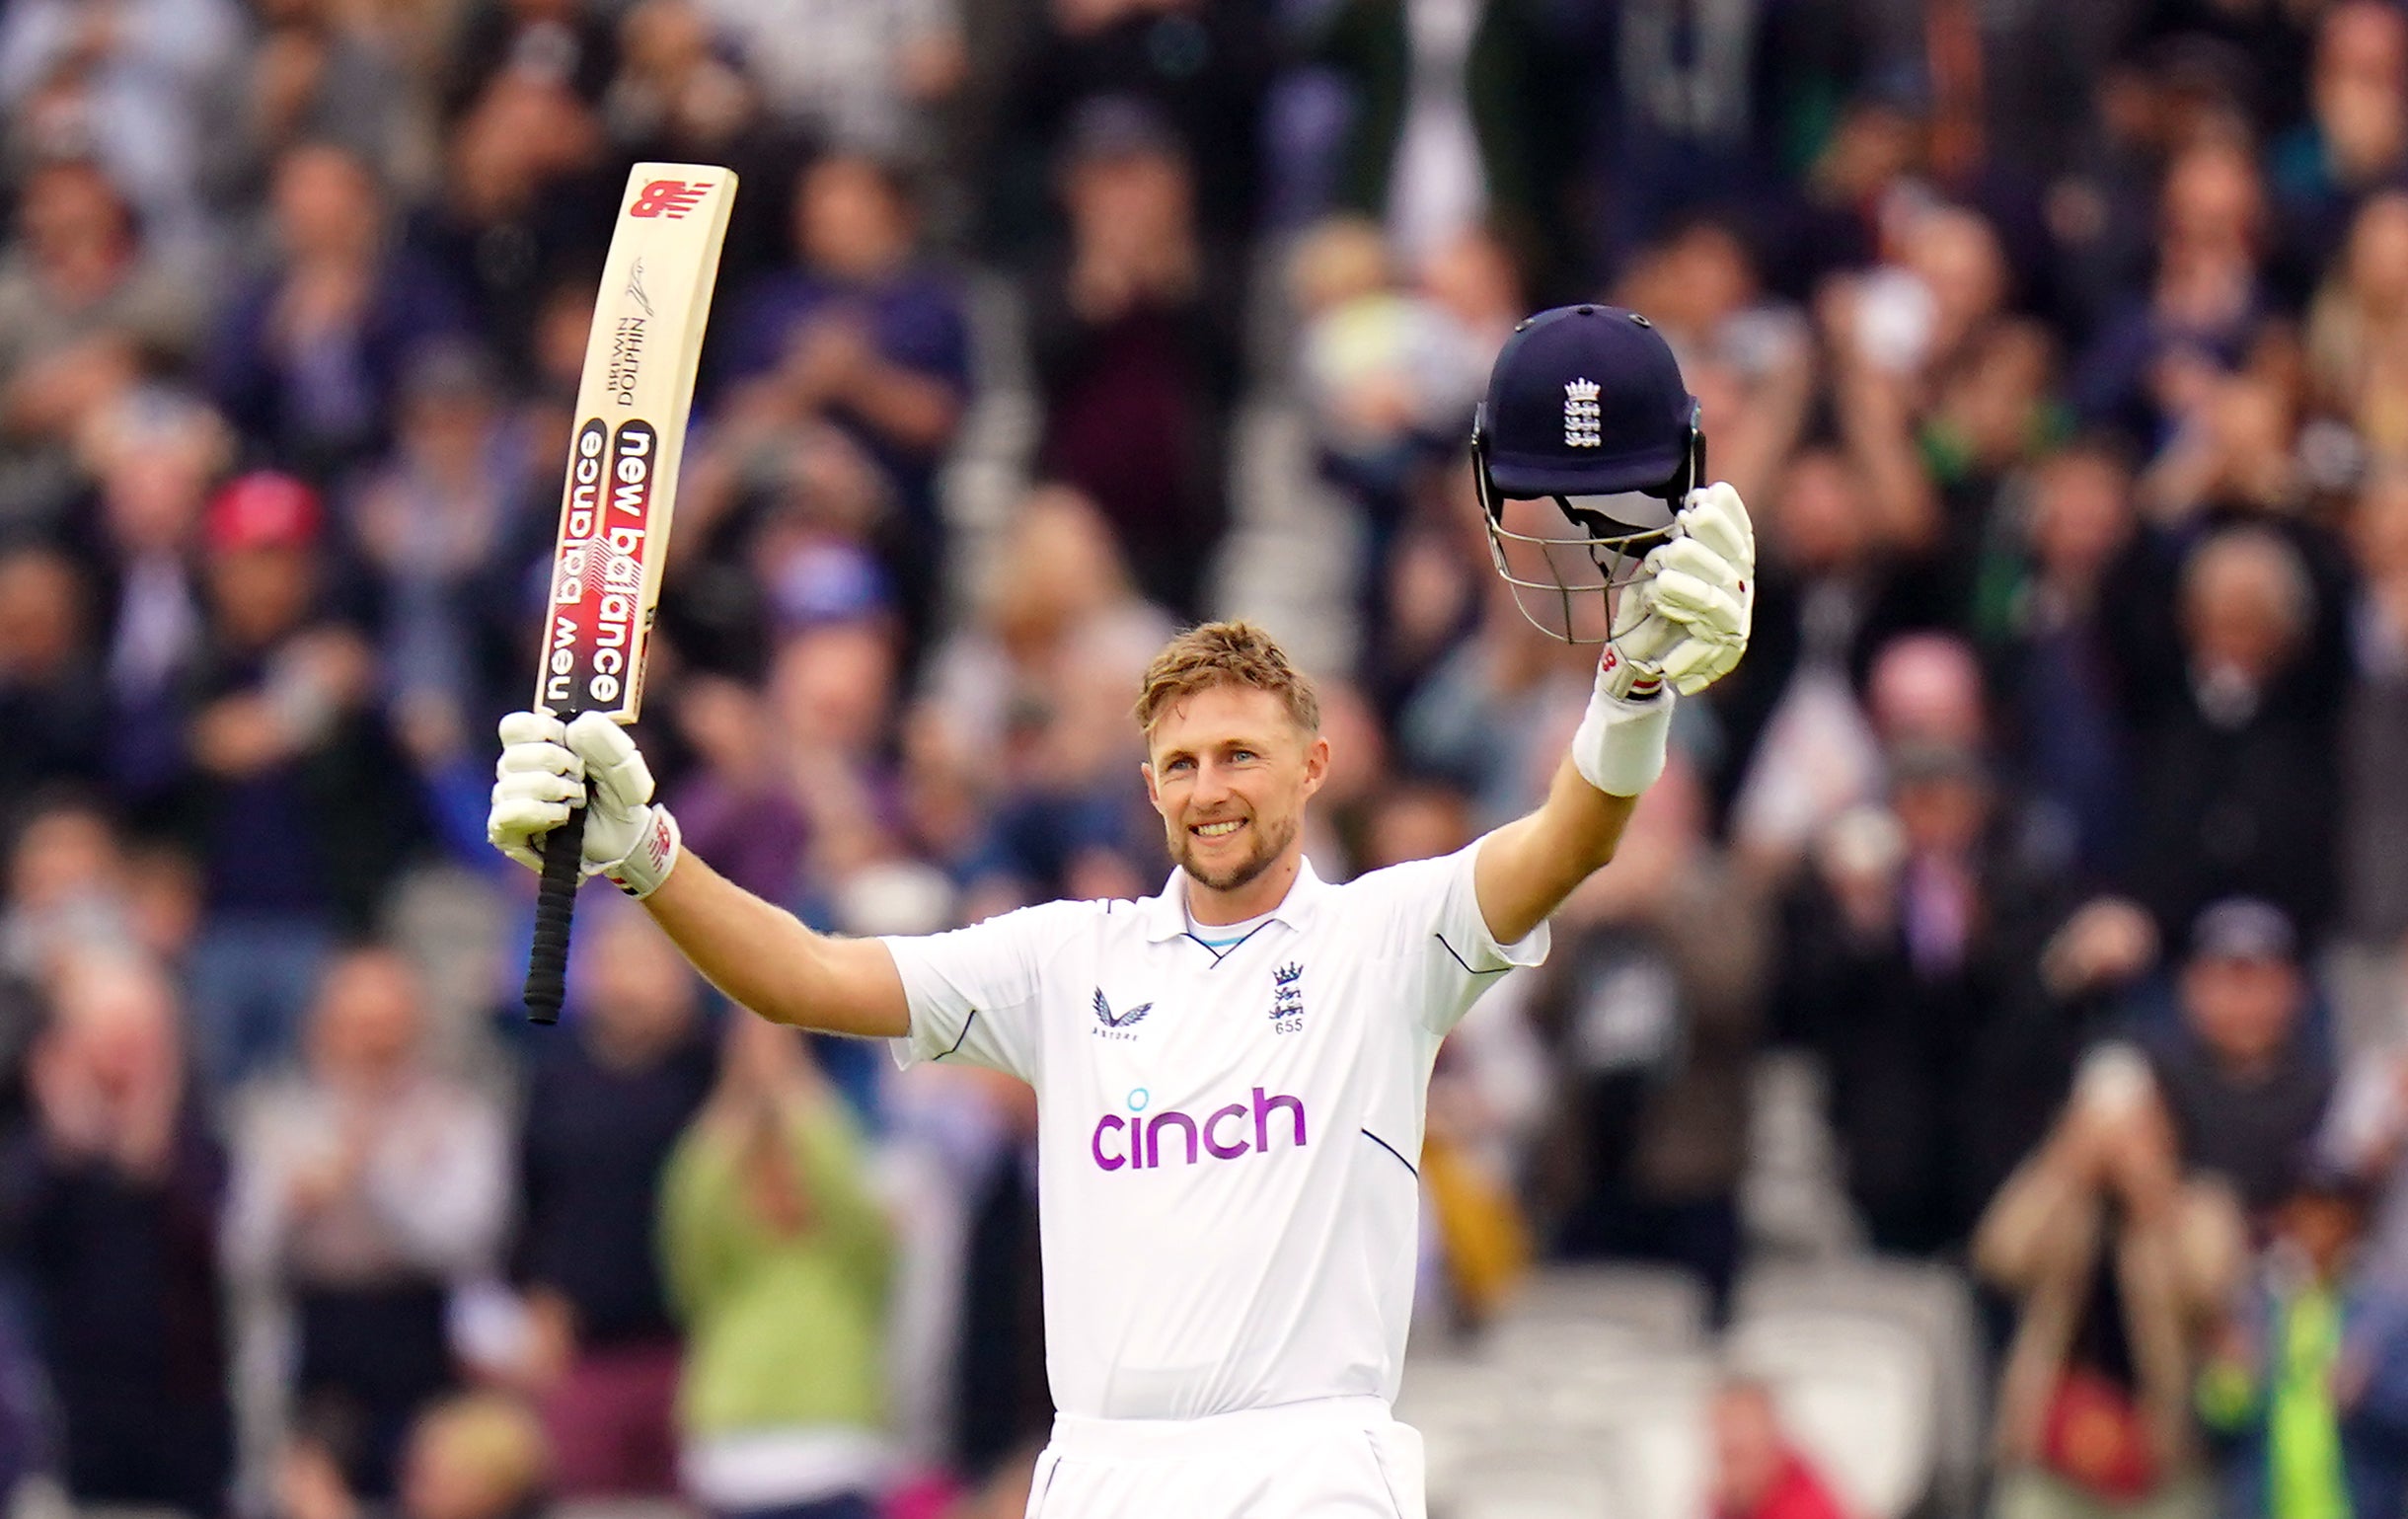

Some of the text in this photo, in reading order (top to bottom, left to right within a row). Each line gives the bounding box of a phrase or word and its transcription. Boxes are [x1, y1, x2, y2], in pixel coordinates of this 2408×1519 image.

[607, 317, 629, 391] BREWIN
[618, 317, 646, 406] DOLPHIN
[547, 430, 602, 701] new balance
[589, 430, 650, 702] new balance
[1275, 1019, 1303, 1034] 655
[1091, 1087, 1307, 1172] cinch
